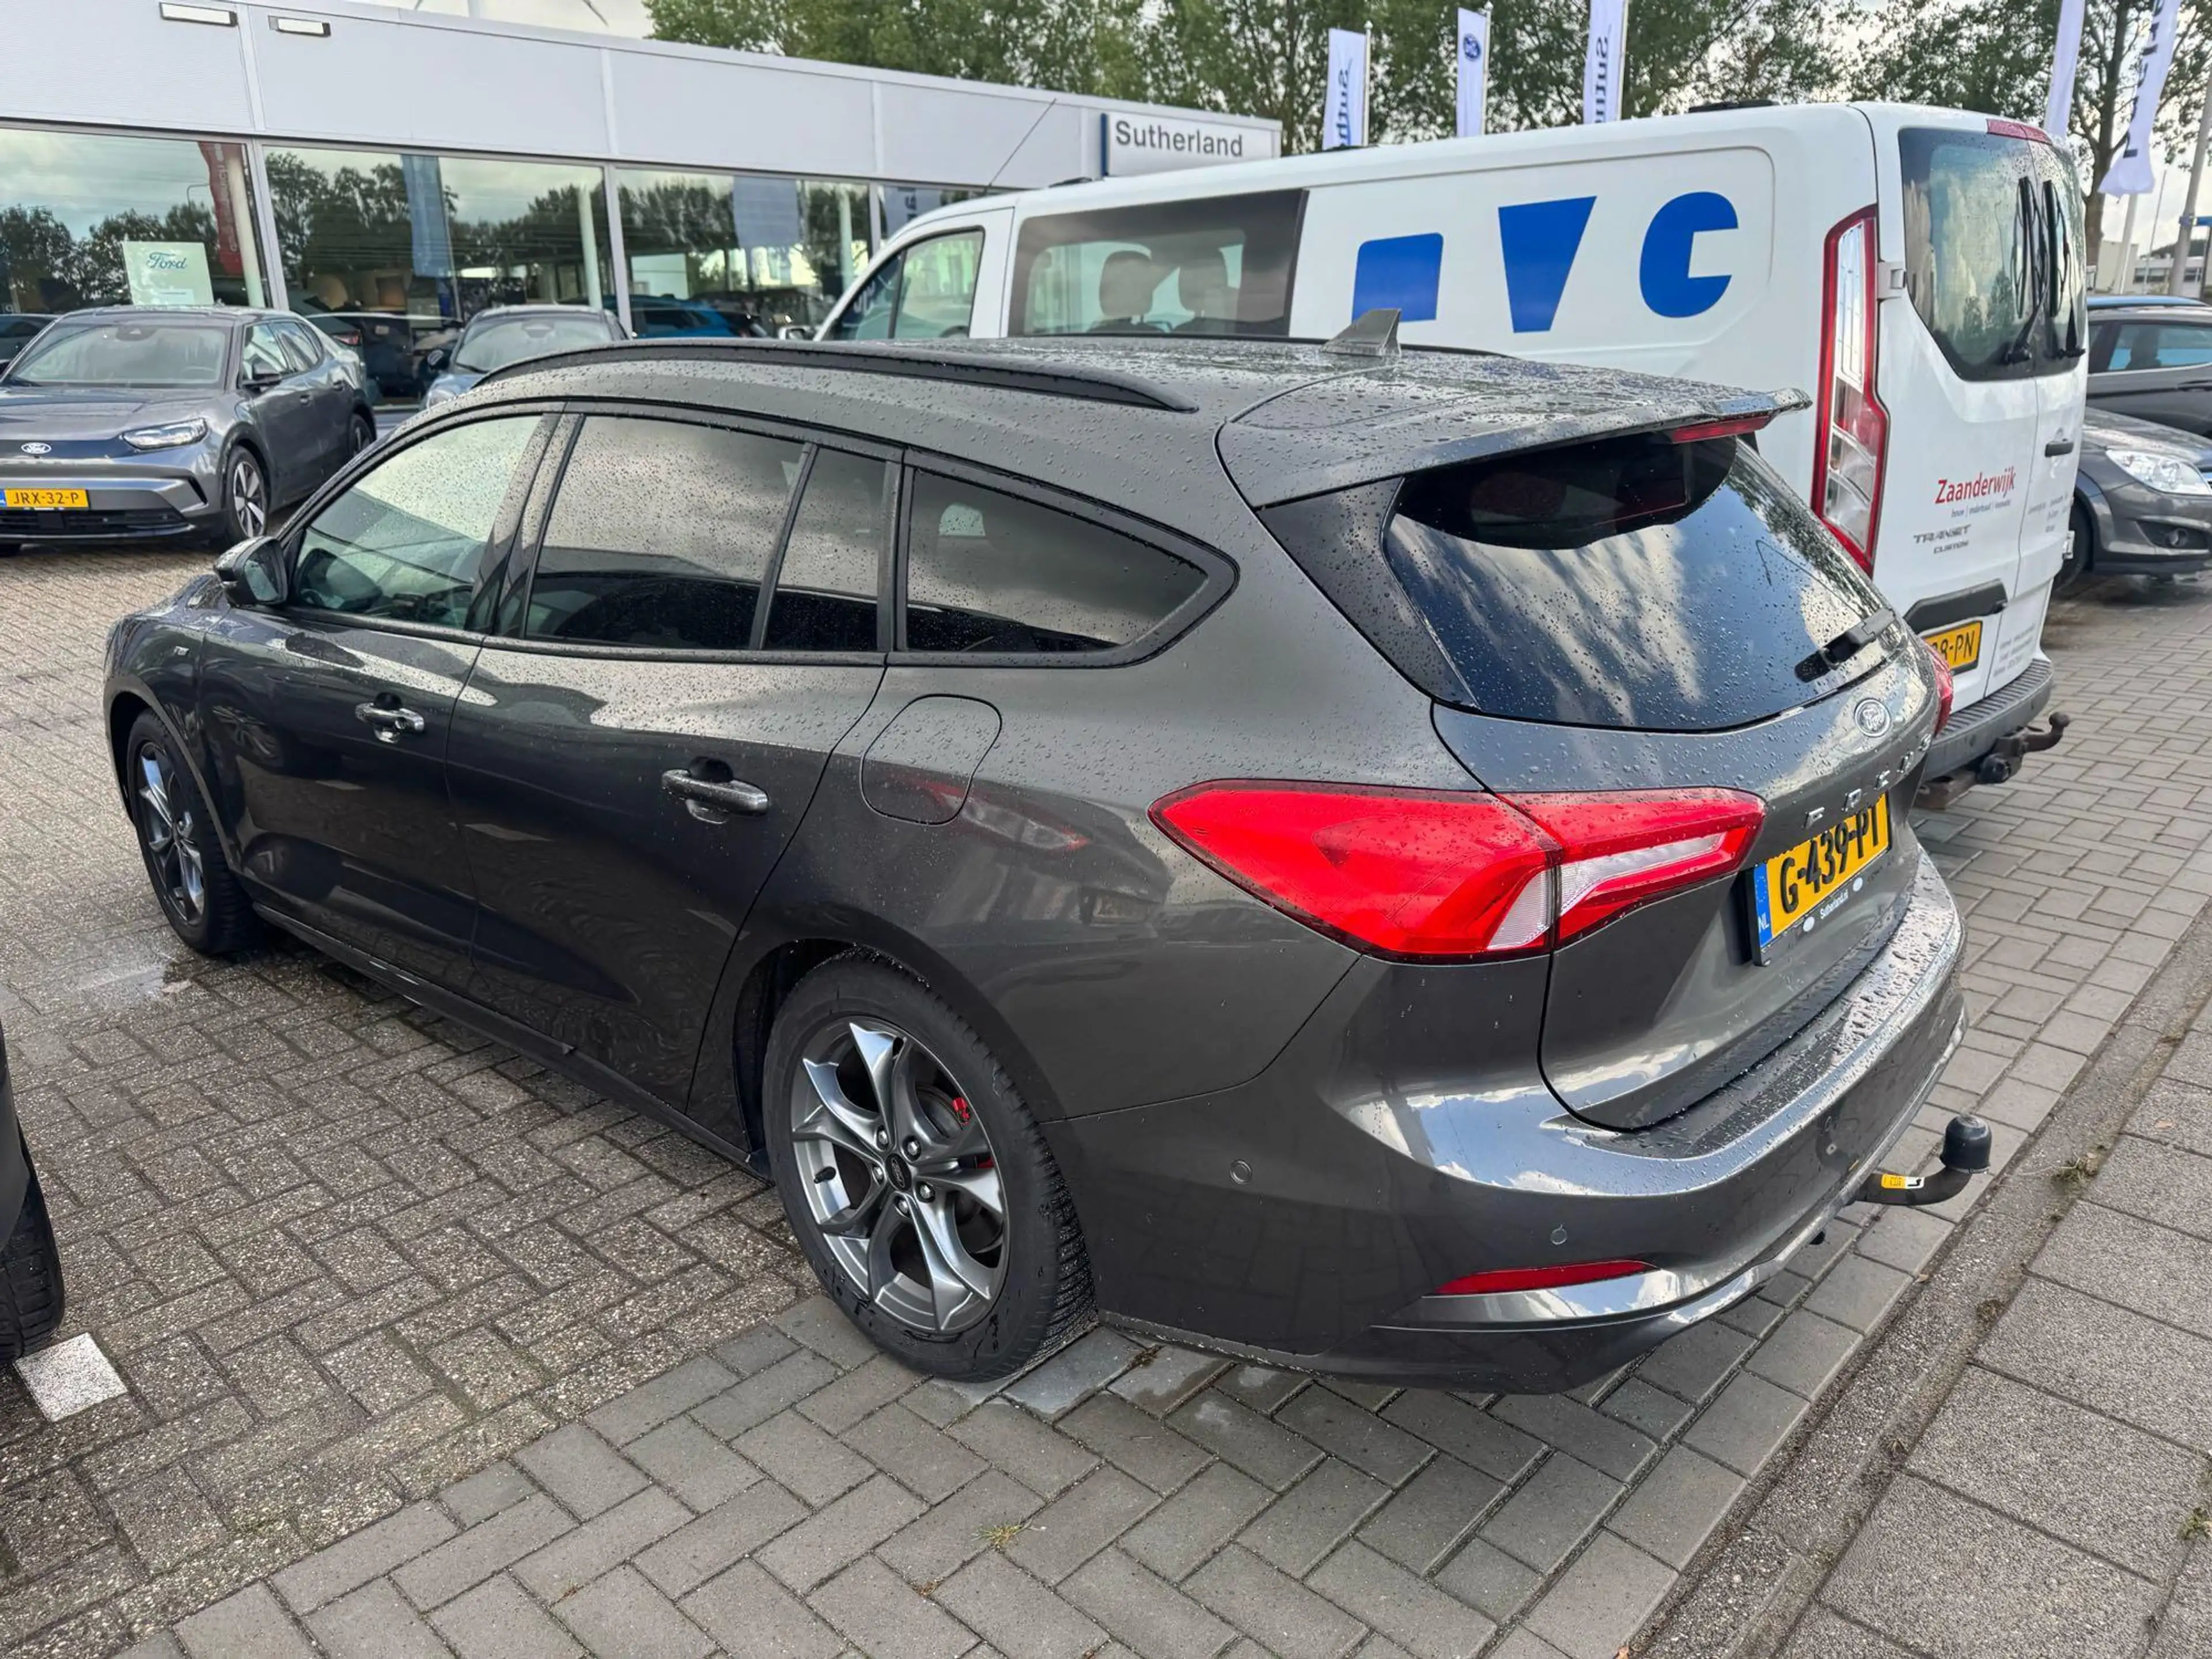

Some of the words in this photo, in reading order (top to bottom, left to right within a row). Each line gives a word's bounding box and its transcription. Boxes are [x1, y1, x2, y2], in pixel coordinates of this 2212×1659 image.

[1115, 120, 1243, 157] Sutherland
[146, 251, 188, 269] Ford
[1934, 465, 2017, 504] Zaanderwijk
[13, 492, 79, 505] JRX-32-P
[1758, 912, 1769, 933] NL
